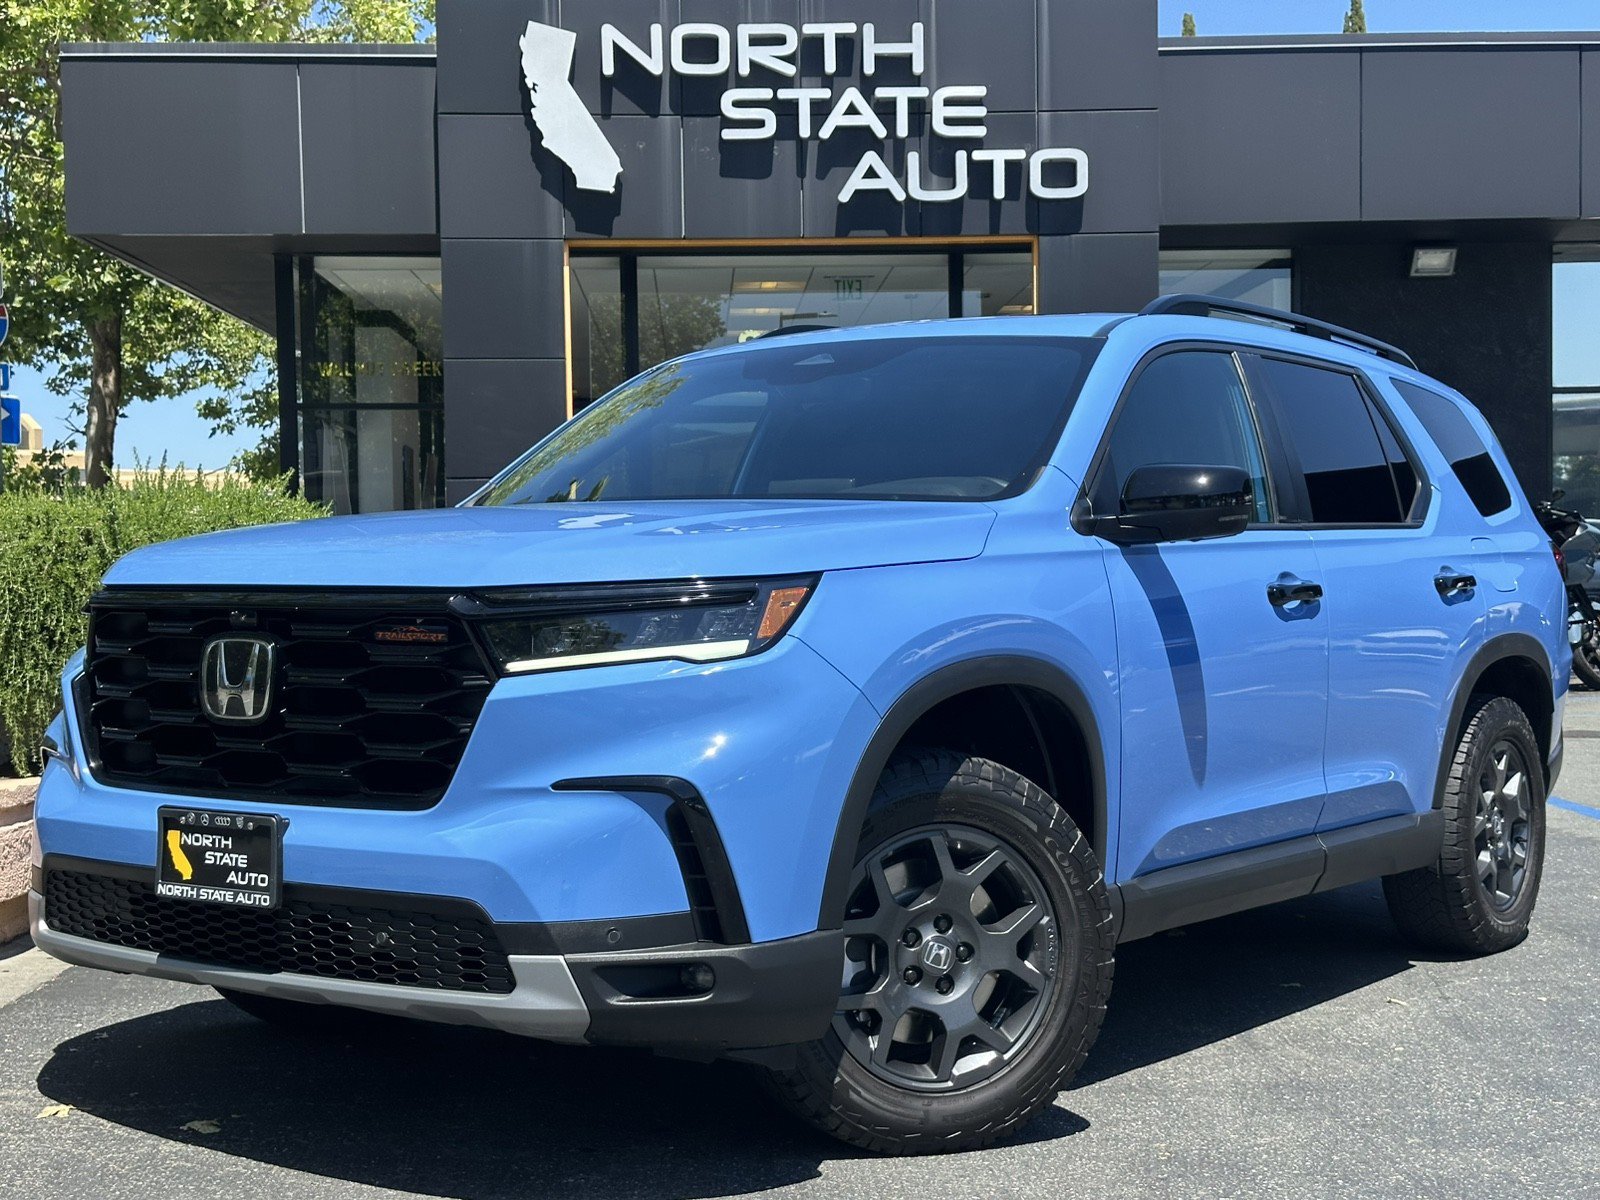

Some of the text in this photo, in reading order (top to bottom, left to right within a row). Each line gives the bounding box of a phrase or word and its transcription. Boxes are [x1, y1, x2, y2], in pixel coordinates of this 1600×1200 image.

[600, 22, 924, 77] NORTH
[719, 85, 987, 140] STATE
[837, 148, 1089, 202] AUTO
[317, 361, 384, 377] WALN
[375, 631, 446, 641] TRAILSPORT
[181, 832, 232, 849] NORTH
[204, 851, 248, 867] STATE
[226, 870, 269, 887] AUTO
[157, 883, 270, 906] NORTH STATE AUTO
